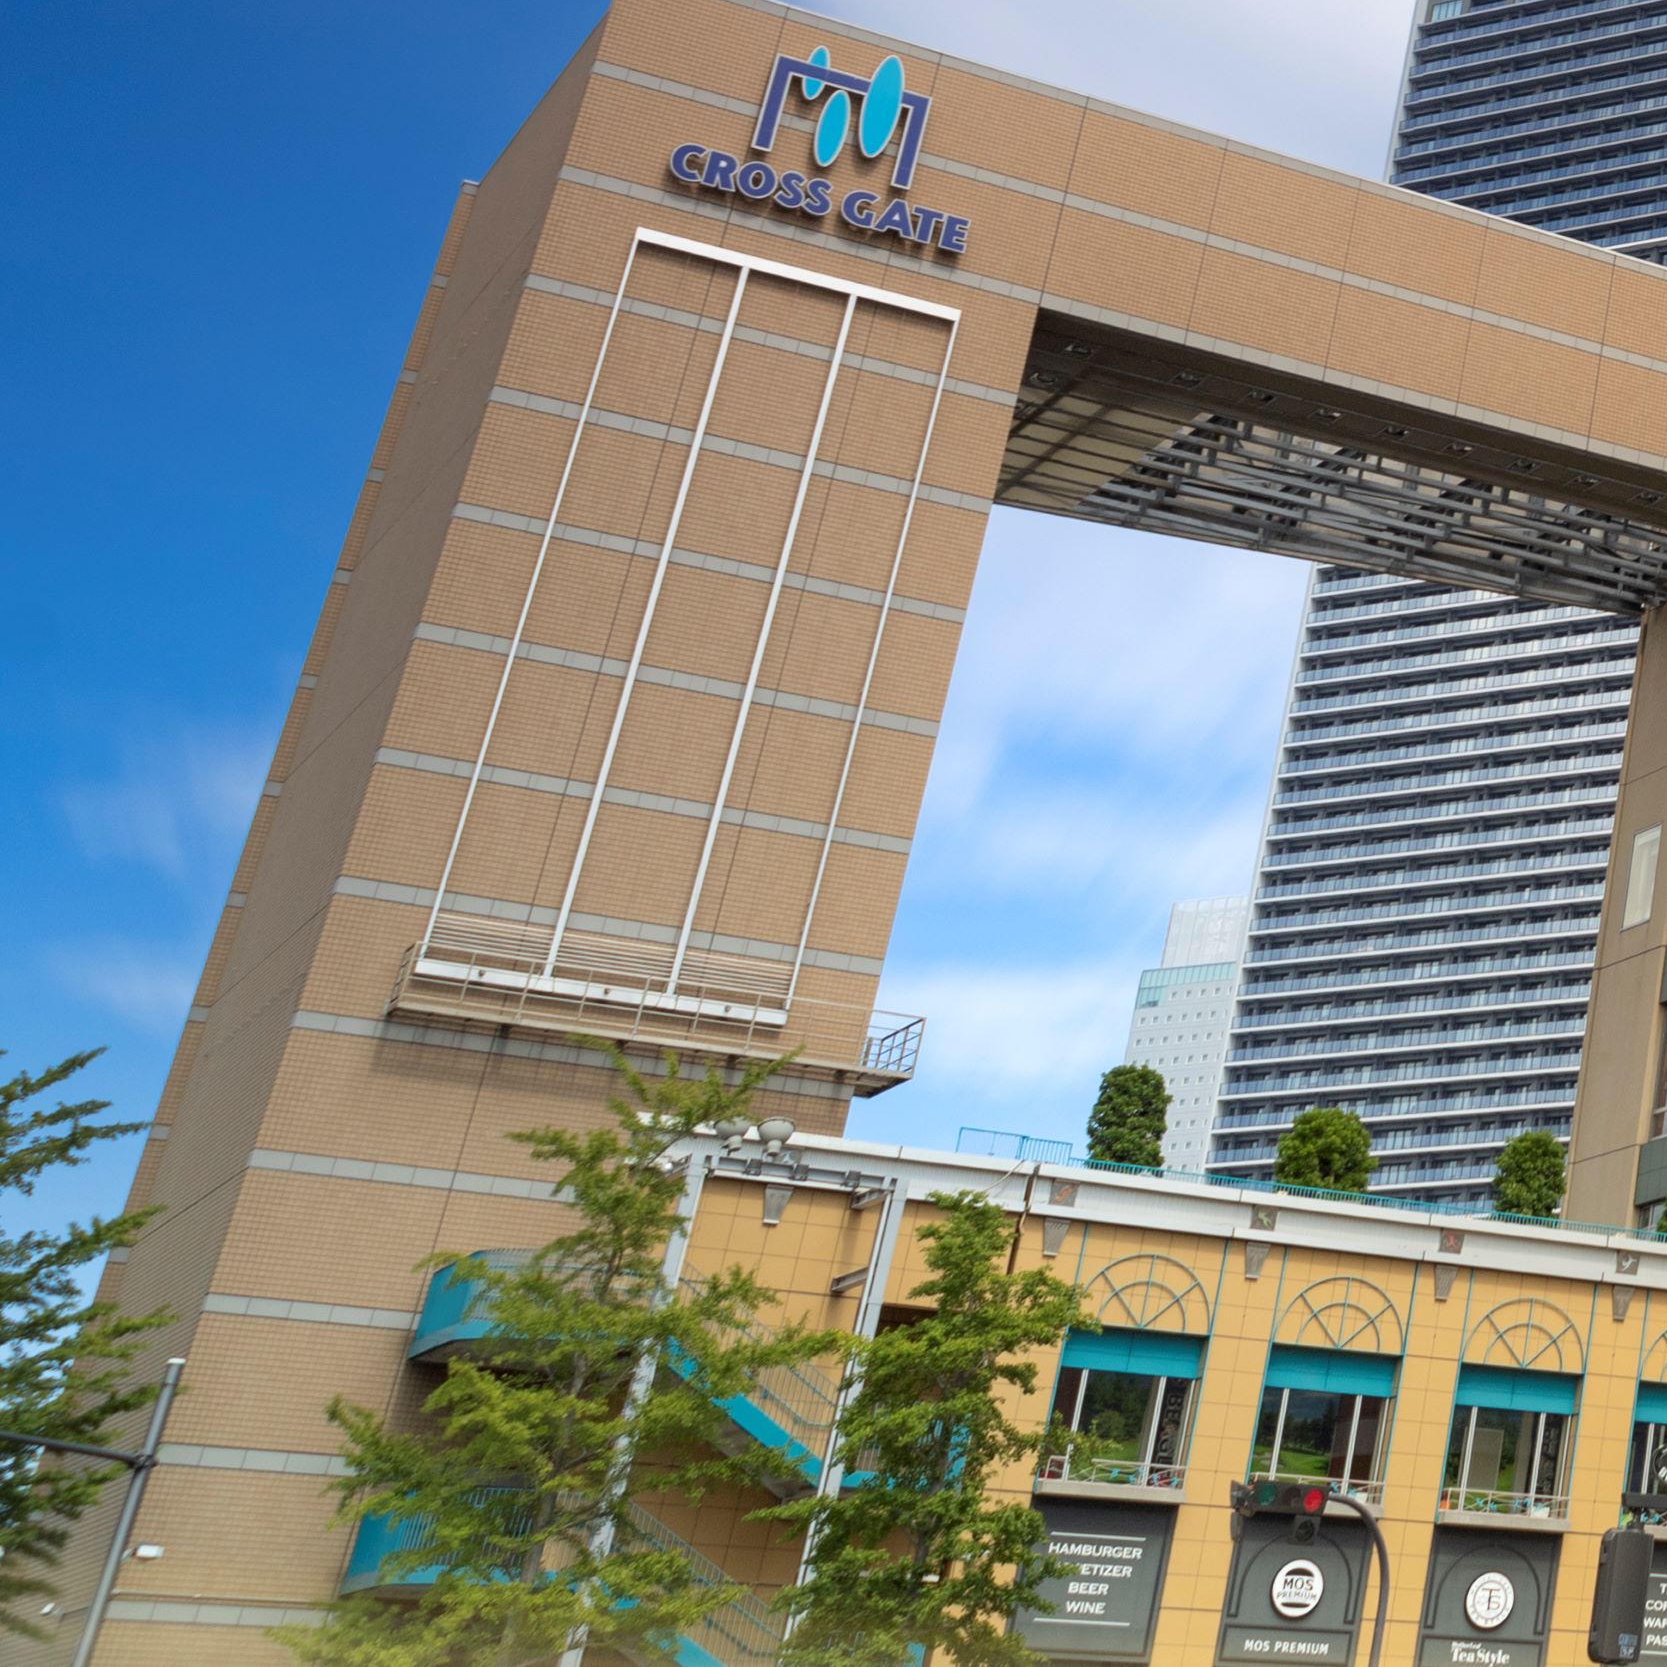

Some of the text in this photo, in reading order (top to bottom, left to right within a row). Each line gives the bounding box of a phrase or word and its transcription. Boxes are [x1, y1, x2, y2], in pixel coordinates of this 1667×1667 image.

[669, 142, 971, 254] CROSS GATE
[1048, 1542, 1143, 1560] HAMBURGER
[1068, 1581, 1109, 1596] BEER
[1283, 1578, 1314, 1591] MOS
[1276, 1590, 1317, 1600] PREMIUM
[1066, 1600, 1106, 1615] WINE
[1244, 1639, 1270, 1652] MOS
[1274, 1640, 1329, 1655] PREMIUM
[1452, 1647, 1510, 1667] Tea Style
